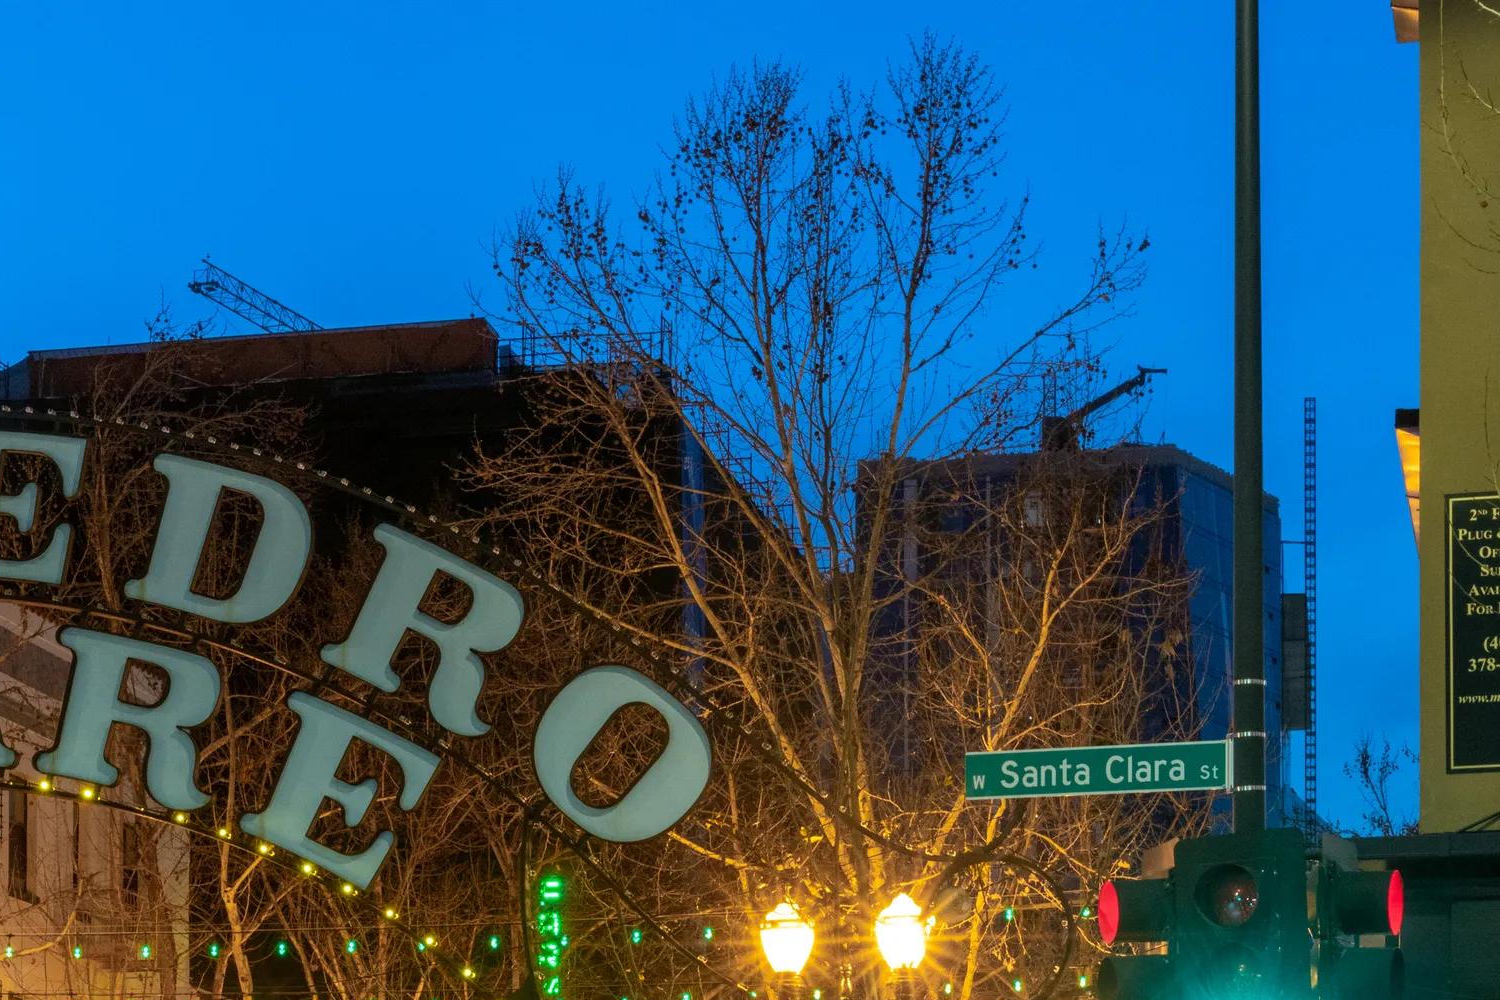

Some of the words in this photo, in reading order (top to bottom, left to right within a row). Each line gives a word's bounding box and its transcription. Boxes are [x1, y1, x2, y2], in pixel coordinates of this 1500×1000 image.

[1458, 528, 1493, 541] PLUG
[1479, 546, 1500, 559] OF
[1466, 603, 1494, 615] FOR
[972, 774, 986, 790] W
[1000, 758, 1090, 789] Santa
[1105, 754, 1186, 784] Clara
[1200, 764, 1219, 780] St
